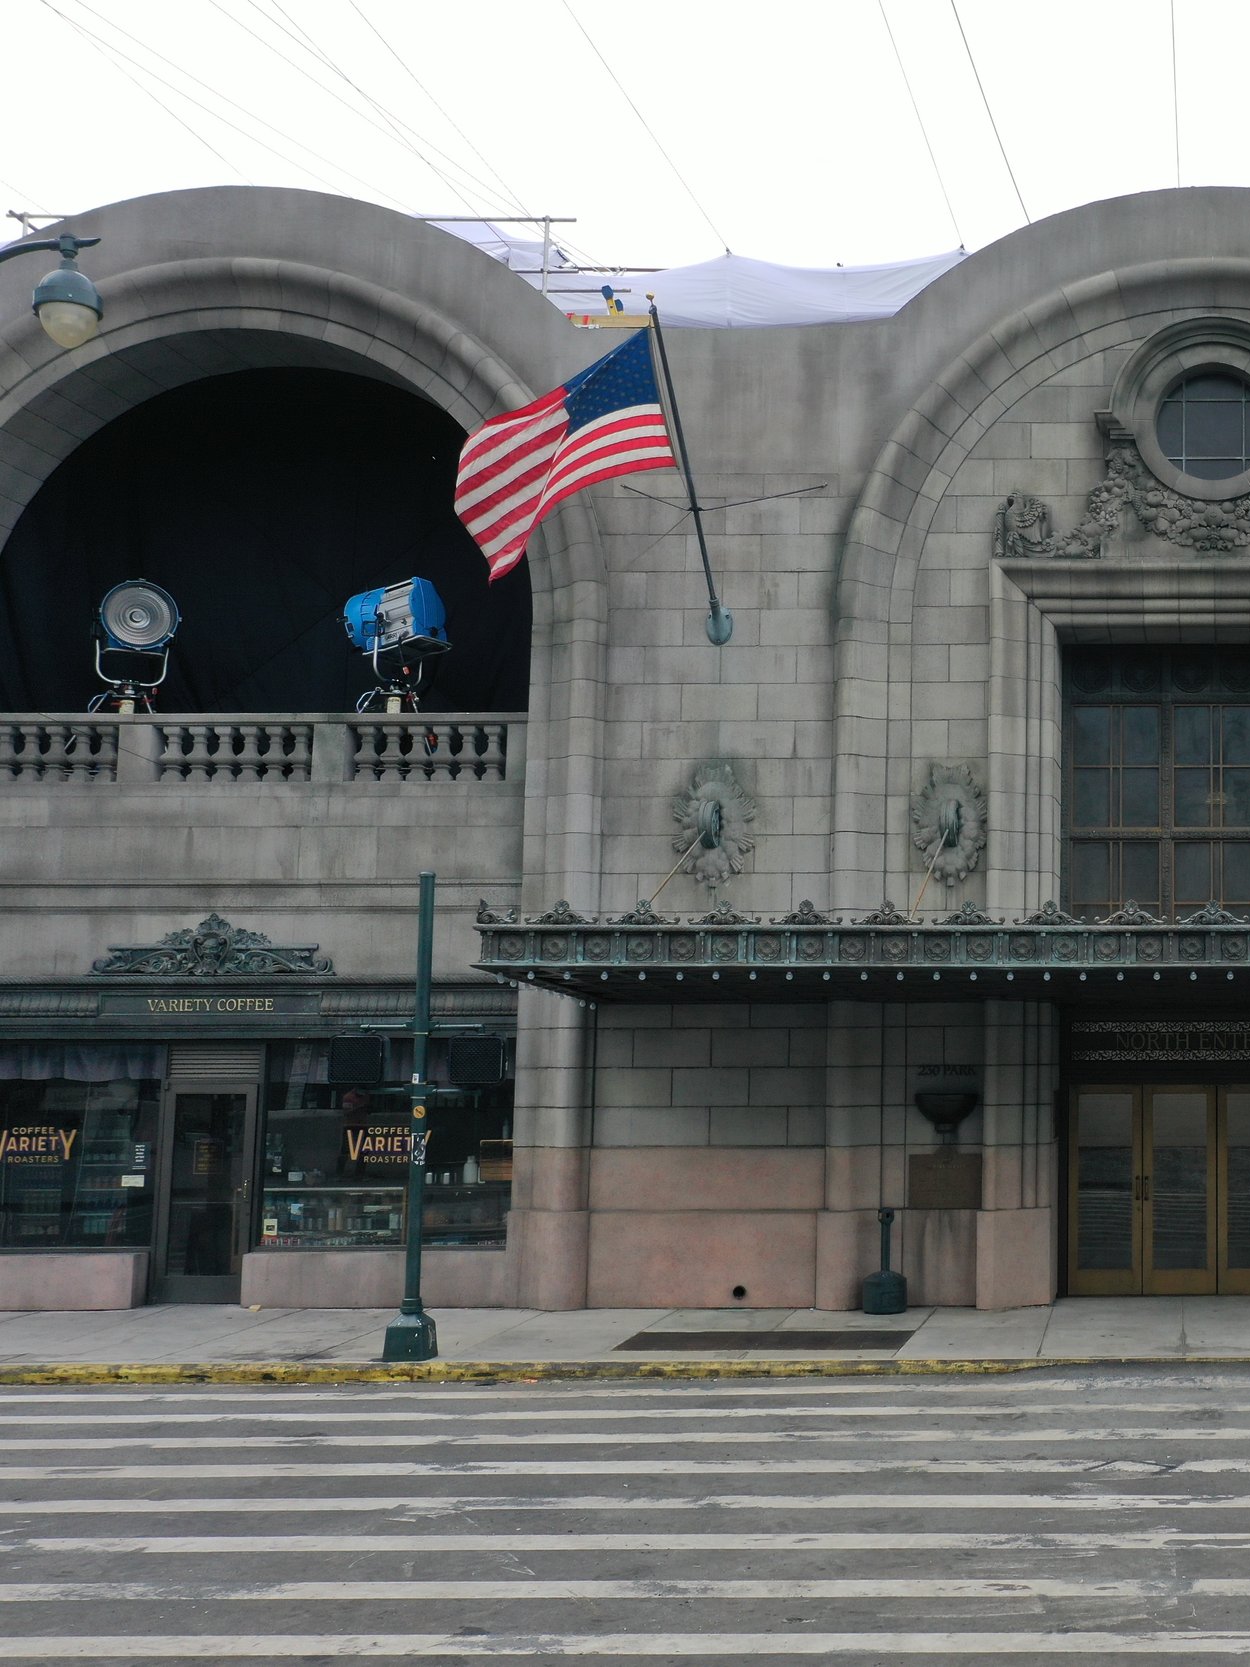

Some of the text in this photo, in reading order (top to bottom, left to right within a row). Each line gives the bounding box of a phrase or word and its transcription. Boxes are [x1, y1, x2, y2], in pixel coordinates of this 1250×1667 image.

[147, 998, 275, 1012] VARIETY COFFEE
[1115, 1032, 1190, 1050] NORTH
[943, 1064, 977, 1077] PARK
[12, 1126, 55, 1135] COFFEE
[367, 1126, 411, 1135] COFFEE
[346, 1129, 432, 1161] VARIET
[7, 1155, 60, 1164] ROASTERS
[363, 1155, 409, 1164] ROASTER
